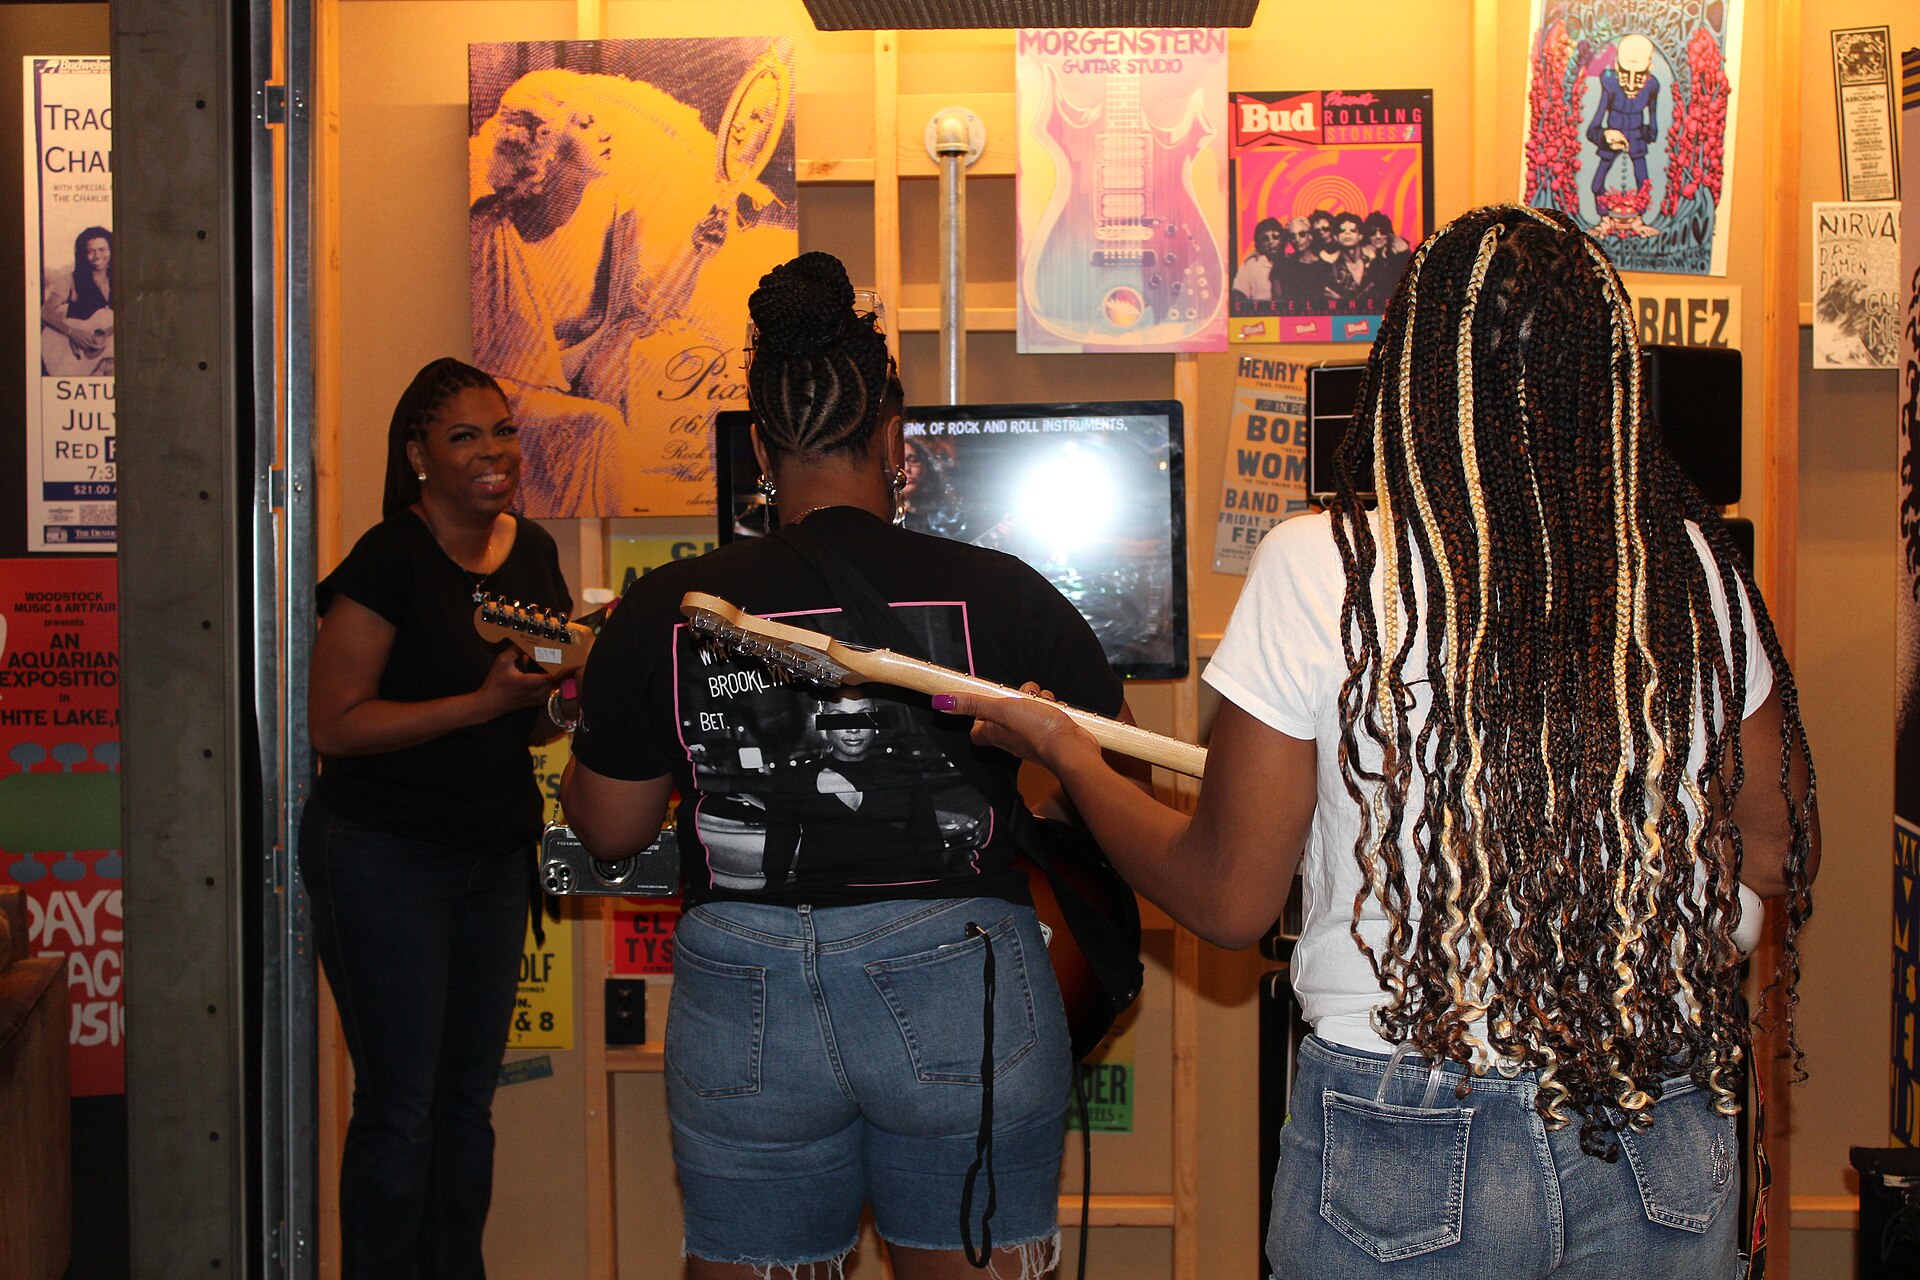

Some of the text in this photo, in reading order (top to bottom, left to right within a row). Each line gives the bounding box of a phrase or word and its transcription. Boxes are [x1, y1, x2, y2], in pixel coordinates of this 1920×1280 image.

[1018, 29, 1224, 56] MORGENSTERN
[1063, 58, 1183, 74] GUITAR STUDIO
[44, 105, 112, 130] TRAC
[1241, 102, 1316, 133] Bud
[1324, 108, 1422, 124] ROLLING
[1328, 126, 1396, 142] STONES
[53, 194, 109, 202] THE CHARLIE
[1820, 212, 1897, 243] NIRVA
[1820, 244, 1857, 265] DAS
[1820, 259, 1867, 291] DAMEN
[1234, 301, 1312, 311] STEEL
[1639, 297, 1729, 347] BAEZ
[657, 345, 748, 401] Pix
[1238, 357, 1306, 383] HENRY'
[1275, 403, 1288, 413] IN
[669, 405, 719, 436] 06/
[930, 422, 944, 435] OF
[948, 421, 980, 435] ROCK
[984, 420, 1007, 433] AND
[1011, 419, 1039, 433] ROLL
[56, 441, 99, 459] RED
[661, 440, 708, 460] Rock
[88, 466, 115, 480] 7:3
[1237, 449, 1306, 482] WOM
[74, 485, 110, 495] $21.00
[1225, 488, 1279, 513] BAND
[1219, 512, 1260, 528] FRIDAY
[25, 592, 104, 601] WOODSTOCK
[14, 603, 116, 613] MUSIC & ART FAIR
[45, 619, 84, 627] presents
[49, 633, 80, 649] AN
[8, 652, 118, 668] AQUARIAN
[0, 670, 117, 687] EXPOSITIO
[59, 692, 70, 702] in
[1, 710, 47, 726] HITE
[700, 712, 731, 732] BET.
[518, 953, 555, 982] OLF
[514, 1011, 554, 1032] & 8
[1083, 1065, 1126, 1104] DER
